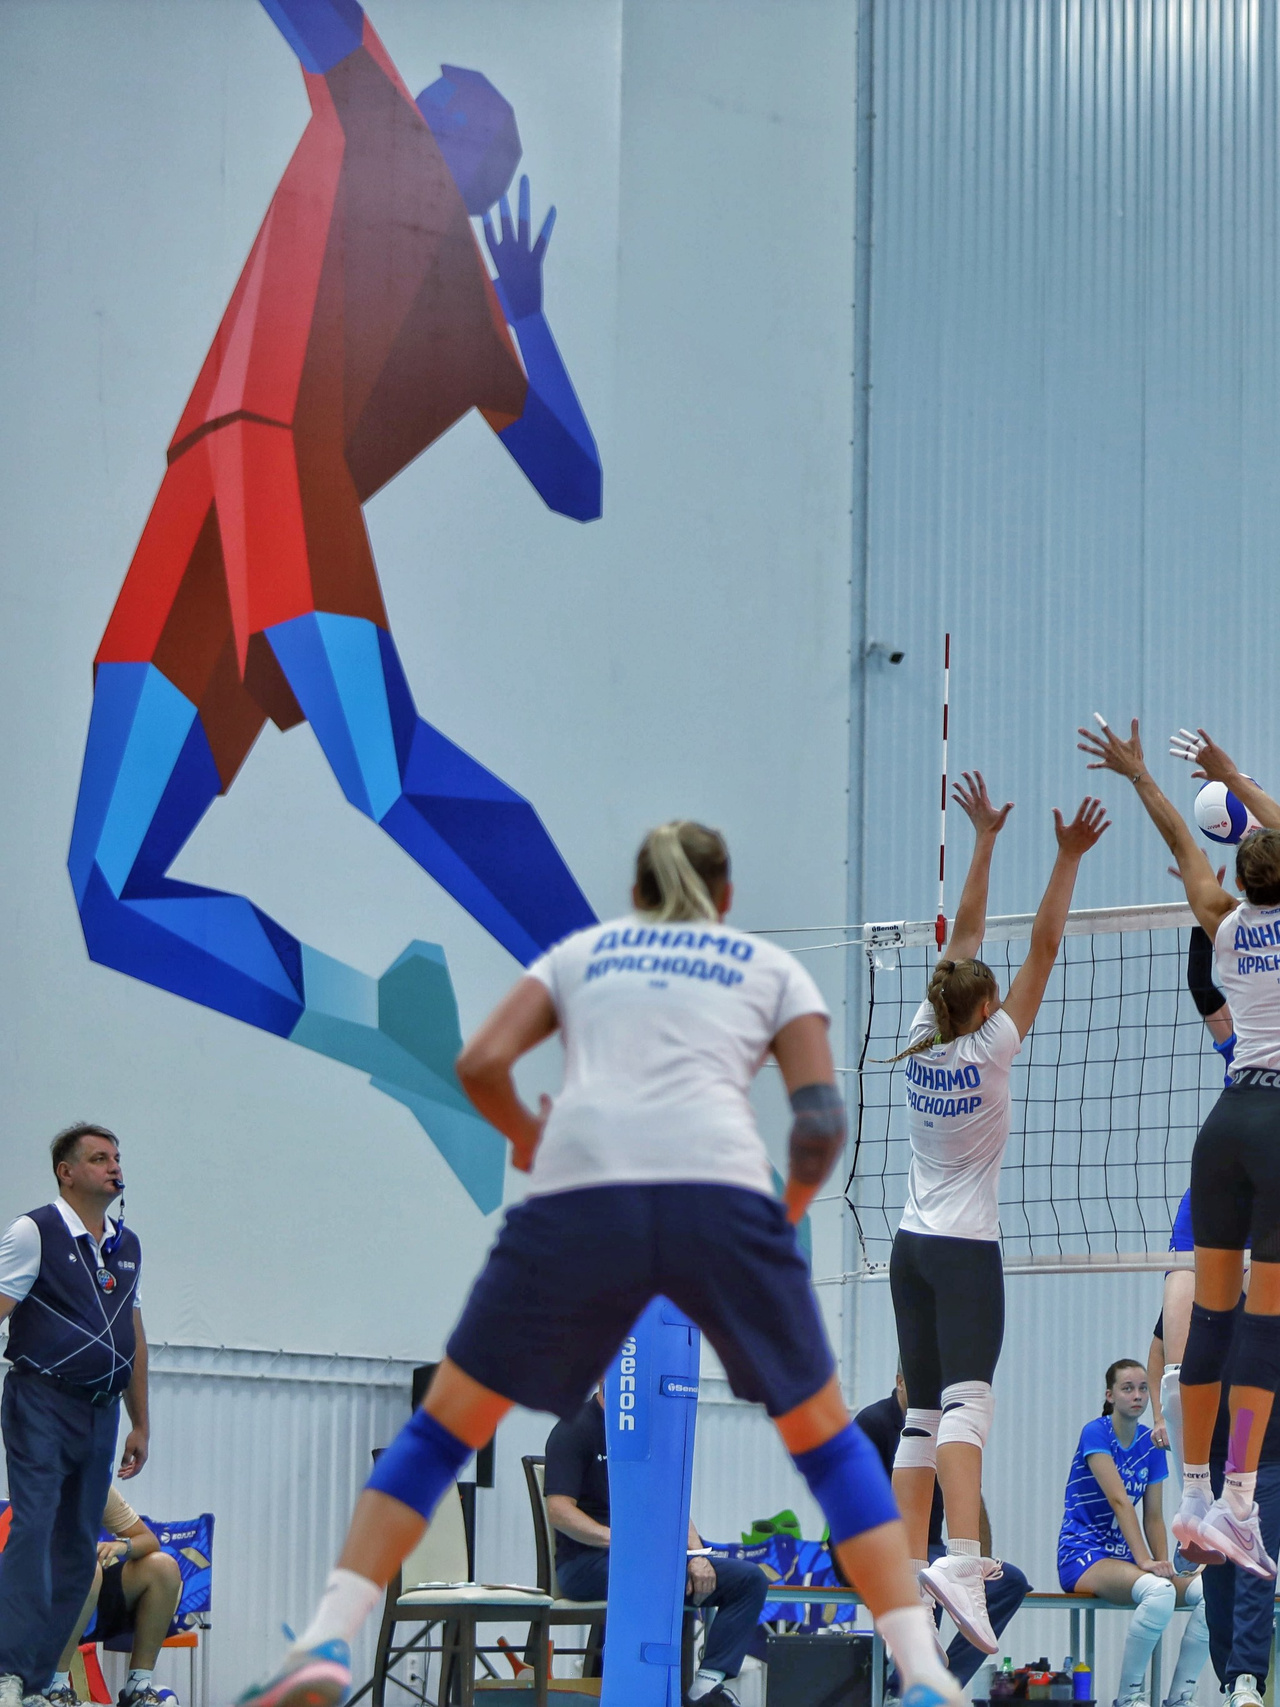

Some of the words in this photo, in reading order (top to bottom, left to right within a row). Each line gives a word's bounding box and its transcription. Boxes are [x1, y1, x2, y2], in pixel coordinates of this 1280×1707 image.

[592, 928, 754, 963] ДИНАМО
[585, 954, 744, 987] КРАСНОДАР
[905, 1056, 981, 1092] ДИНАМО
